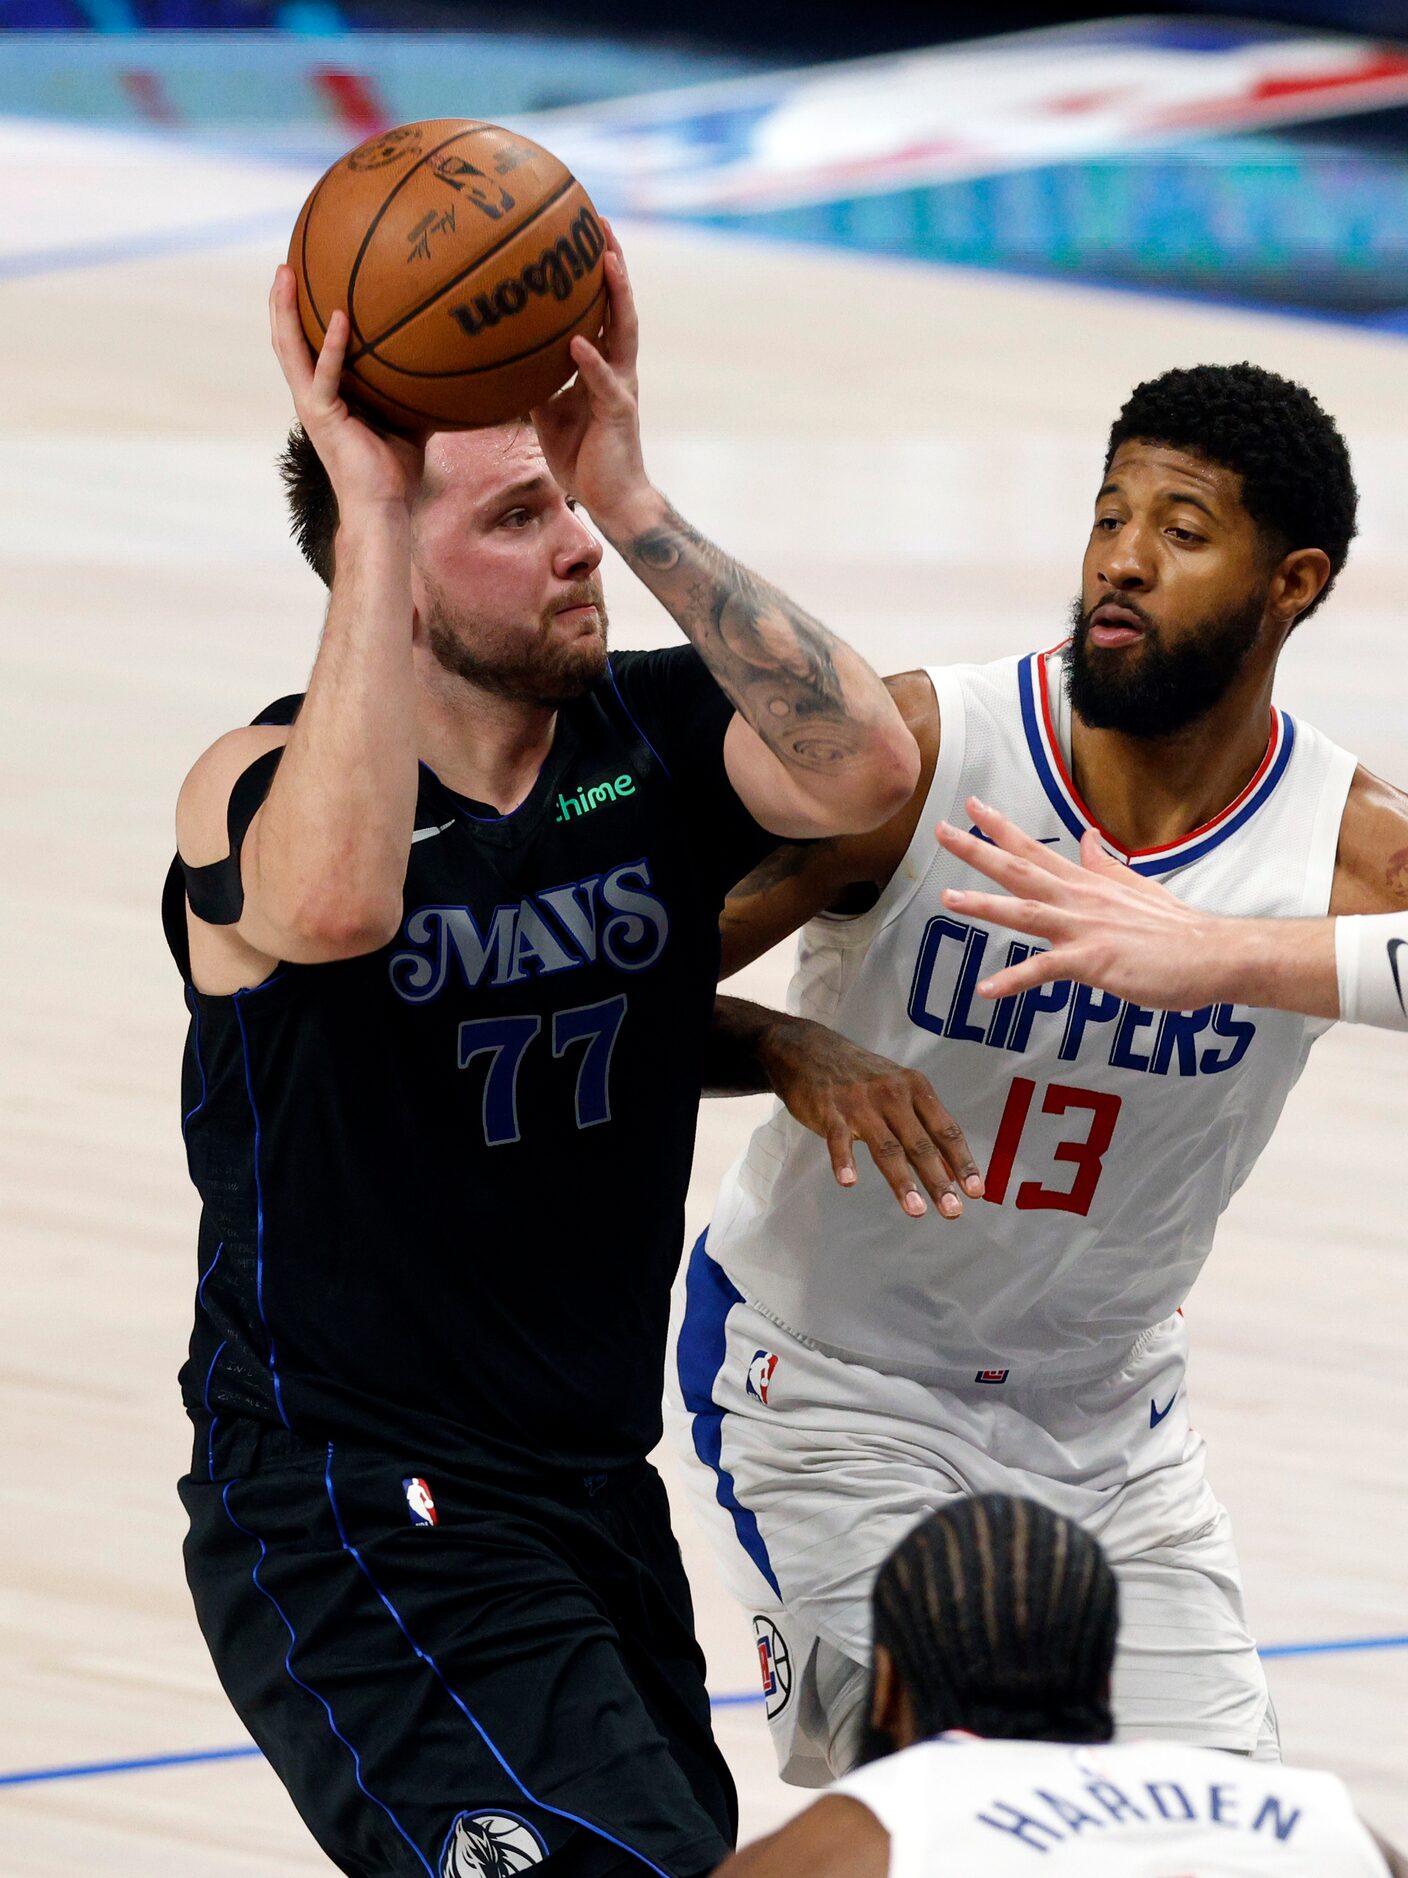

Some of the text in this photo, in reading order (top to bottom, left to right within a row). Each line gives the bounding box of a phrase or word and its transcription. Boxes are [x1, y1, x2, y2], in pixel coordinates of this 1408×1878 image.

[449, 206, 603, 336] Wilson
[556, 774, 636, 822] hime
[389, 857, 668, 1005] MAVS
[457, 993, 628, 1147] 77
[981, 1076, 1123, 1217] 13
[976, 1779, 1302, 1854] HARDEN
